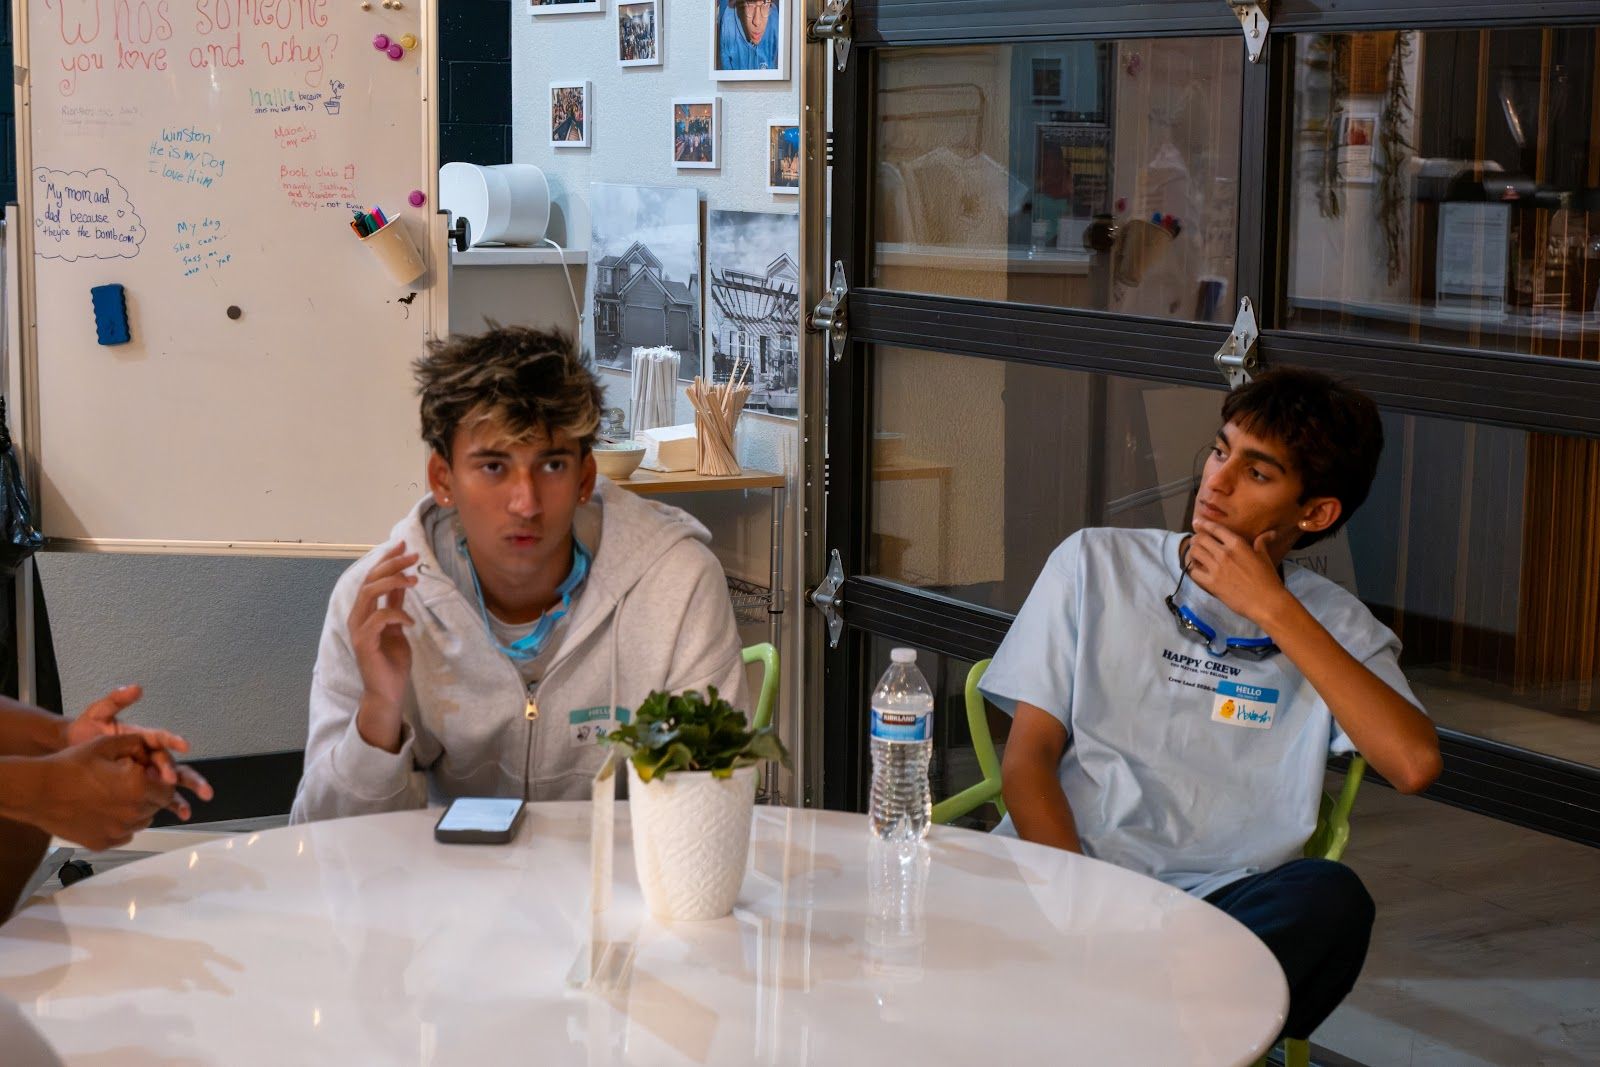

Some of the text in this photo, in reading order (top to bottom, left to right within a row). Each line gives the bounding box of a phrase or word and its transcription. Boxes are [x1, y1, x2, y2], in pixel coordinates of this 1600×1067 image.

[59, 53, 104, 96] you
[189, 32, 244, 68] and
[261, 33, 339, 87] why?
[150, 141, 164, 156] He
[202, 152, 225, 177] Dog
[280, 164, 308, 180] Book
[47, 183, 110, 208] My mom and
[45, 203, 110, 223] dad because
[77, 225, 90, 238] the
[177, 221, 196, 237] My
[1162, 648, 1242, 677] HAPPY CREW
[1235, 685, 1262, 697] HELLO
